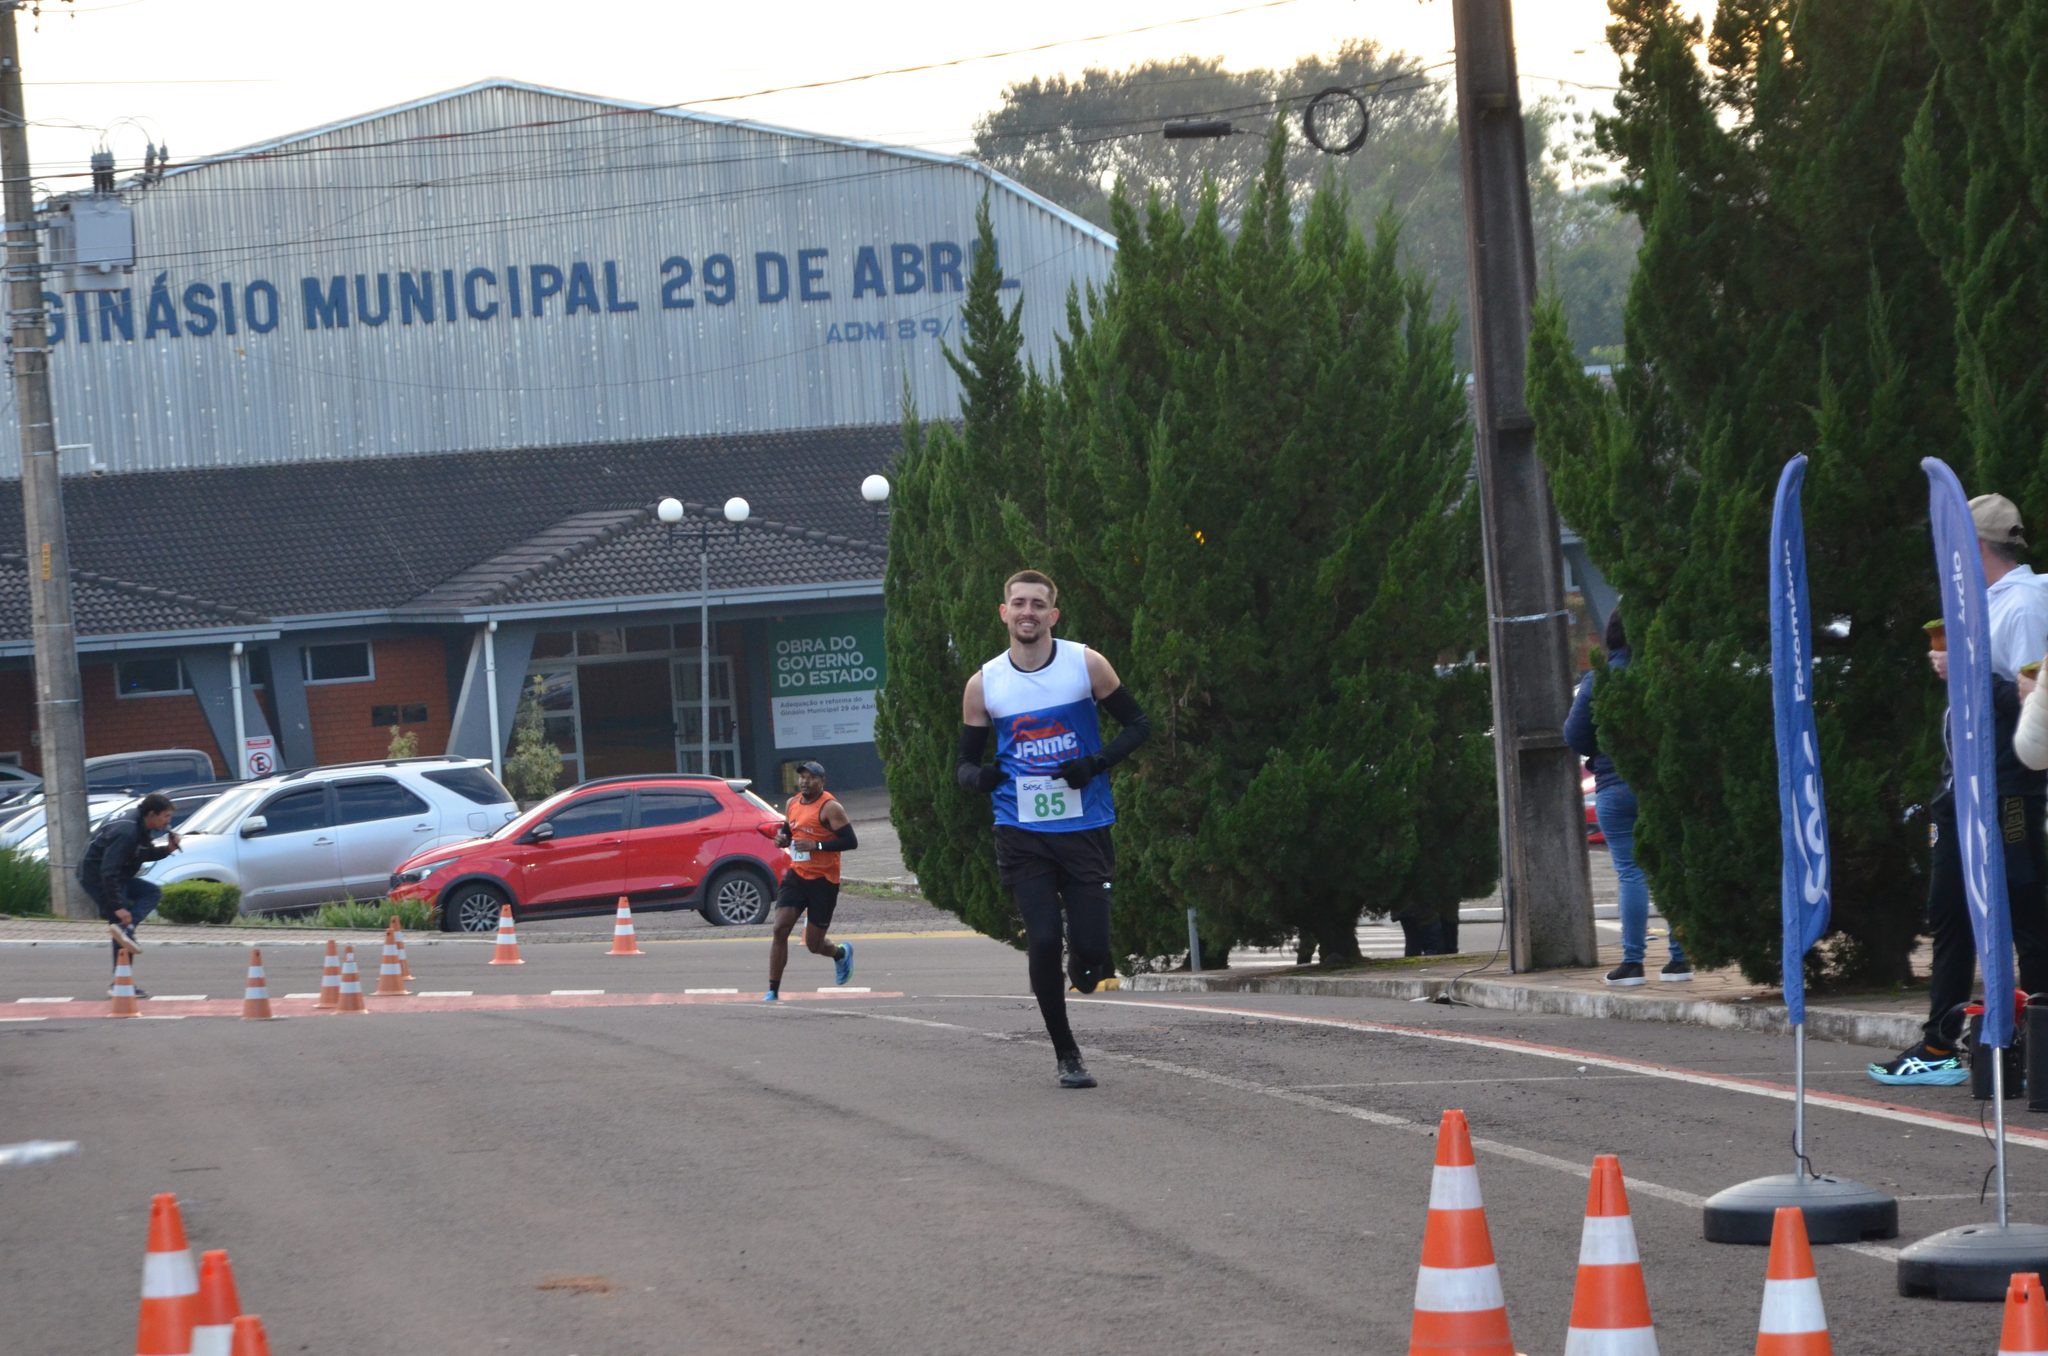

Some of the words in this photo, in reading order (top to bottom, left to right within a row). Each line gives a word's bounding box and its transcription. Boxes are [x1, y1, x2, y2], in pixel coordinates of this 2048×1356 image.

[41, 271, 279, 345] GINÁSIO
[303, 260, 638, 330] MUNICIPAL
[661, 256, 735, 308] 29
[755, 248, 831, 303] DE
[827, 320, 885, 344] ADM
[898, 316, 969, 341] 89/
[776, 638, 826, 655] OBRA
[830, 635, 857, 650] DO
[777, 651, 864, 671] GOVERNO
[779, 672, 805, 688] DO
[809, 667, 877, 686] ESTADO
[1034, 792, 1066, 817] 85
